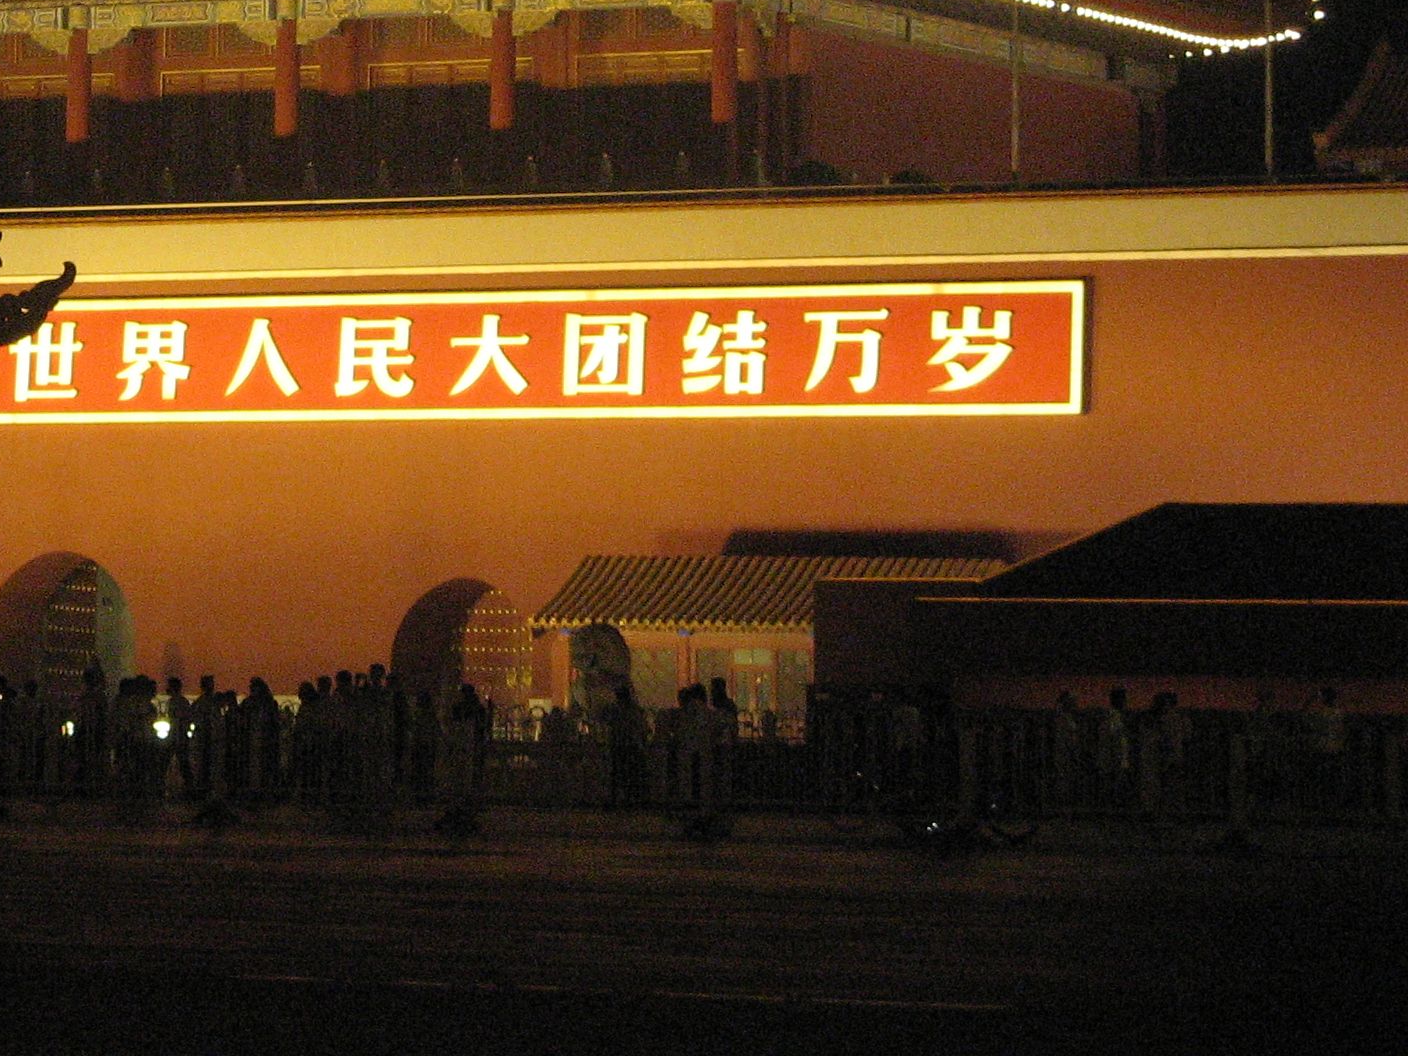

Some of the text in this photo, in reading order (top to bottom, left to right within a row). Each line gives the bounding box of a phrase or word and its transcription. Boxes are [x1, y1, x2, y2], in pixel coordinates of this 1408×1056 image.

[8, 305, 1014, 403] 世界人民大团结万岁
